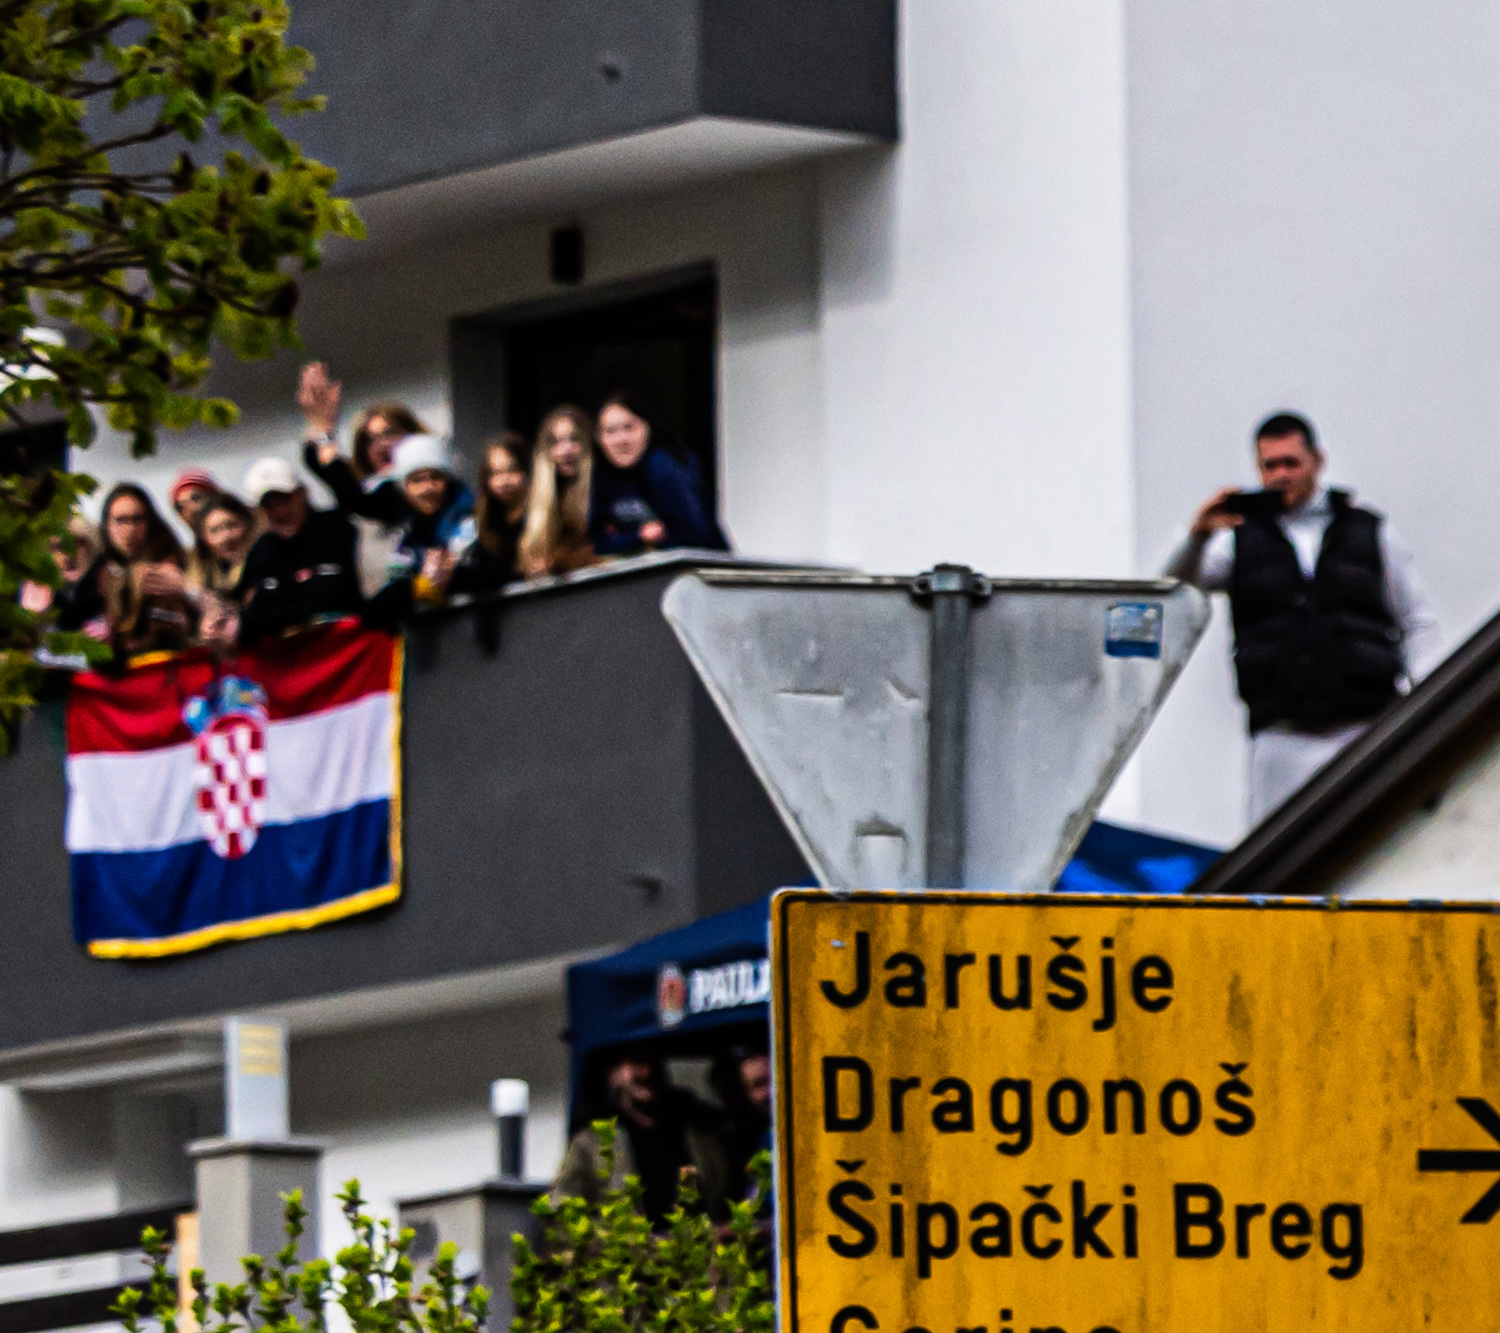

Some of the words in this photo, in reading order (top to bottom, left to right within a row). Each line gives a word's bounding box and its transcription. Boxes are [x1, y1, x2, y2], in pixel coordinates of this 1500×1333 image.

[819, 931, 1176, 1031] Jarušje
[820, 1056, 1257, 1156] Dragonoš
[826, 1160, 1142, 1277] Šipački
[1172, 1183, 1365, 1279] Breg
